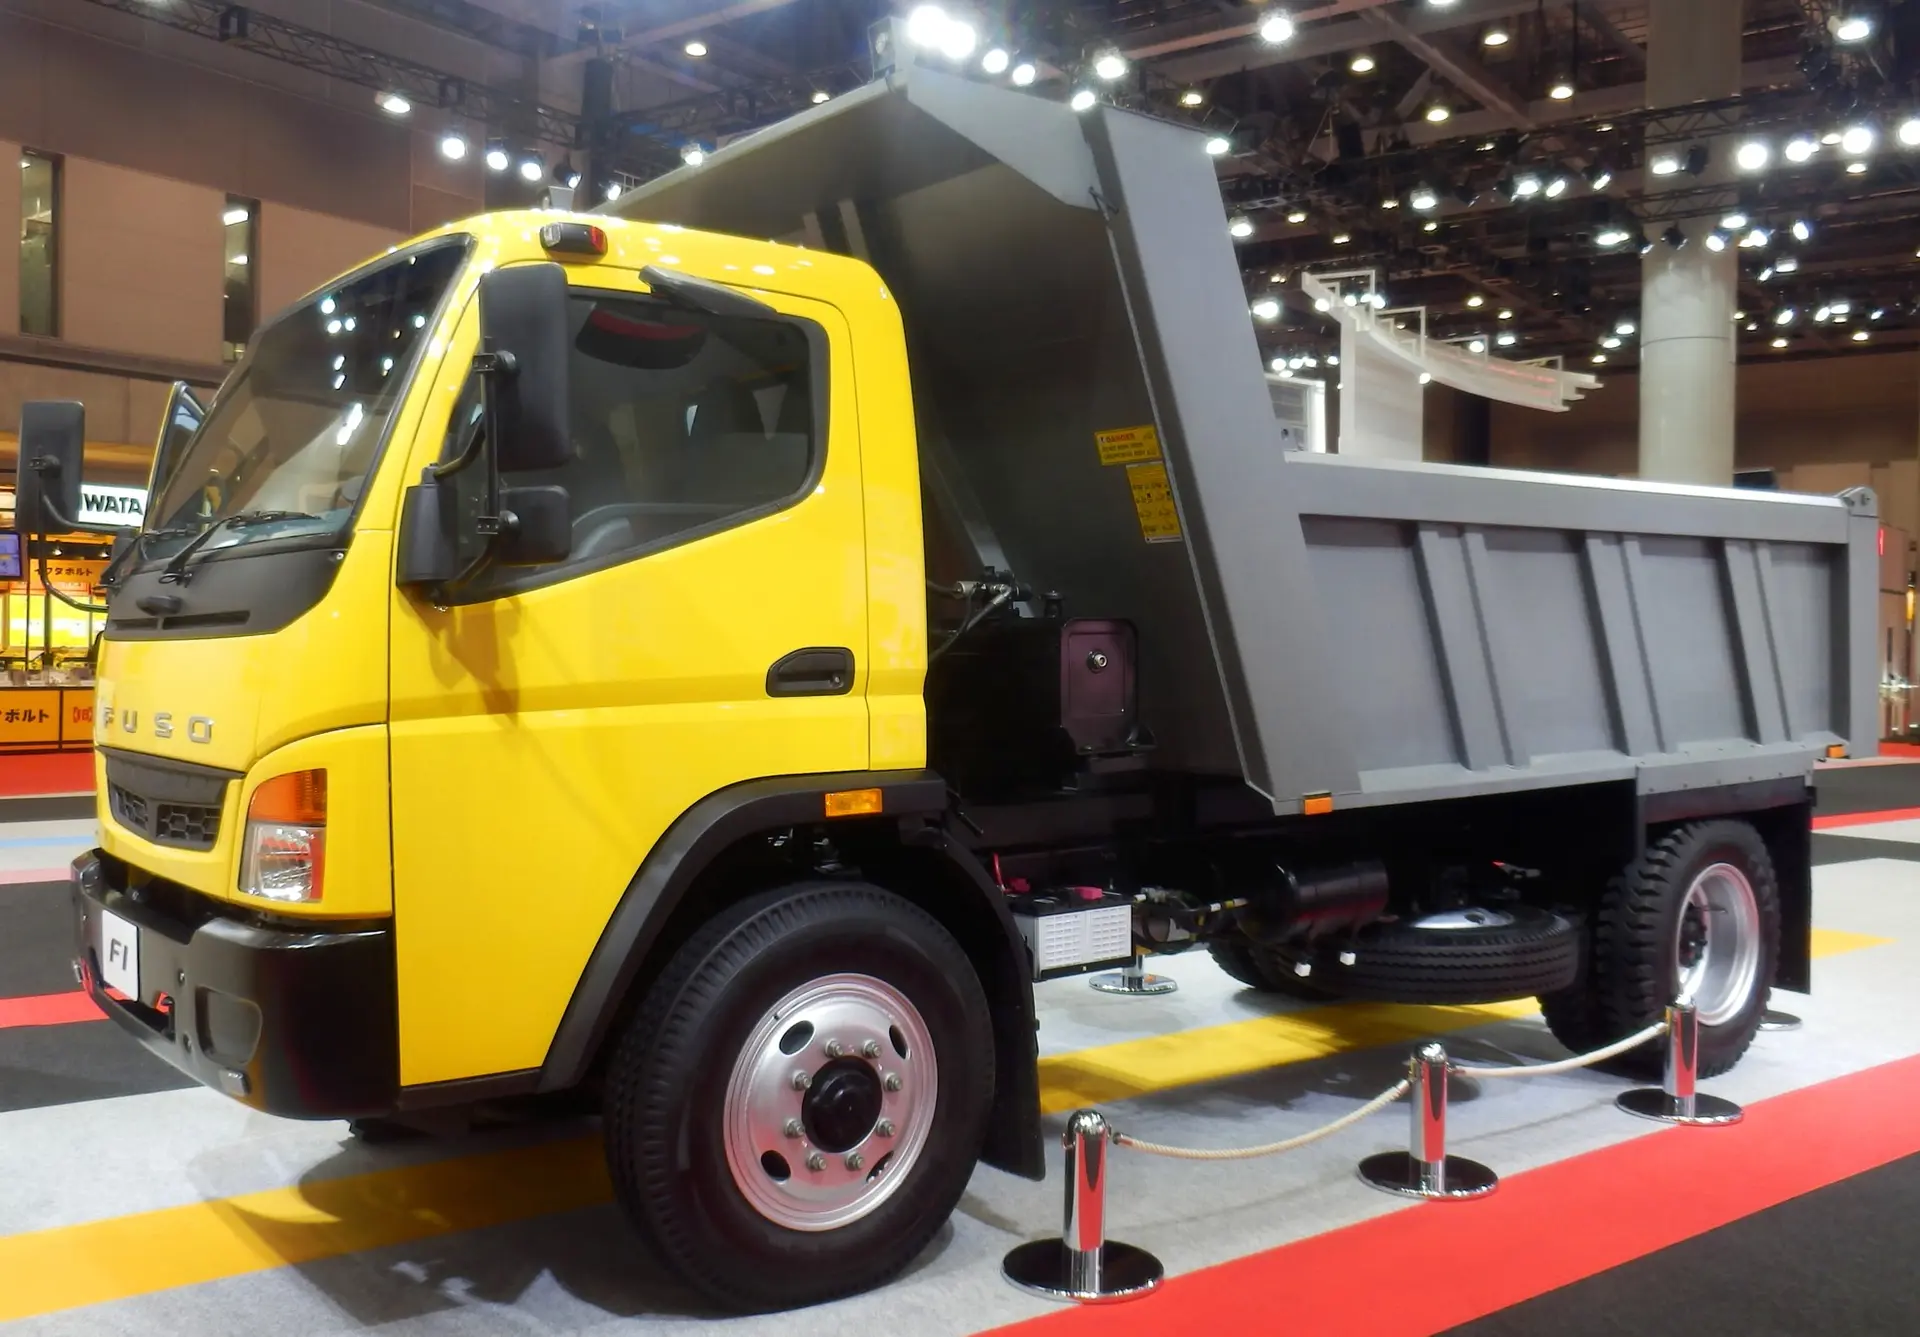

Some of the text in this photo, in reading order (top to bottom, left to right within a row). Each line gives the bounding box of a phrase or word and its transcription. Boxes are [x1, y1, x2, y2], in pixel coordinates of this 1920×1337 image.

[0, 708, 50, 723] ボルト
[103, 706, 215, 744] FUSO
